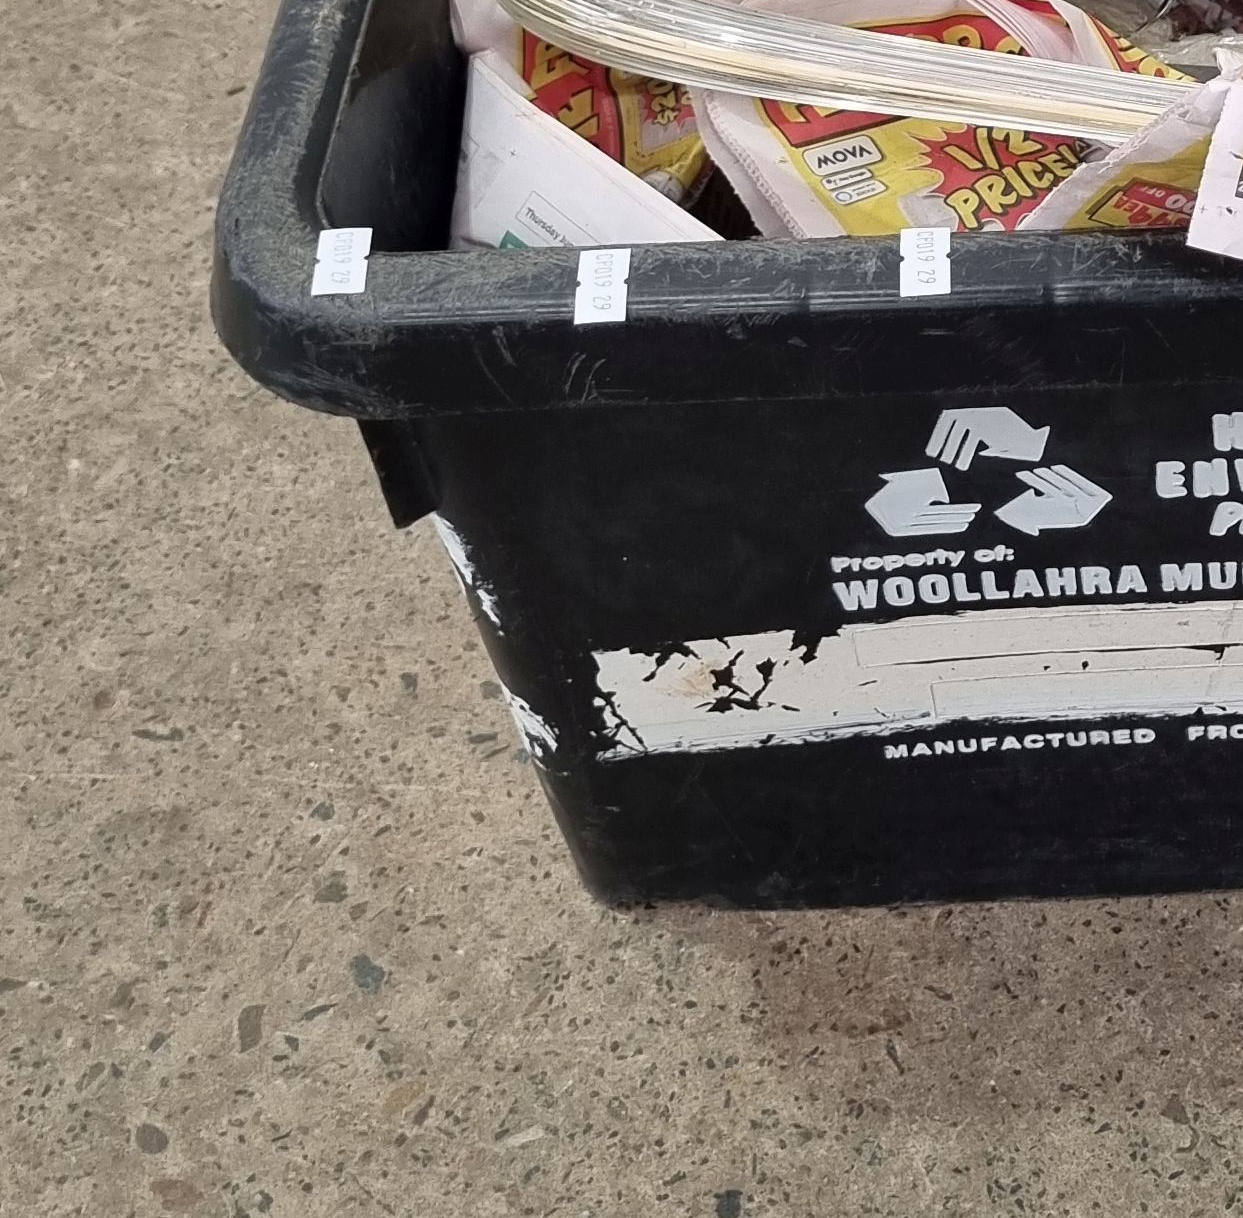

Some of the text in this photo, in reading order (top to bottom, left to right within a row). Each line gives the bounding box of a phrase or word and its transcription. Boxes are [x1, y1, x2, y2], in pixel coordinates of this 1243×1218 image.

[817, 144, 873, 169] MOVA
[944, 144, 1080, 229] PRICE!
[525, 205, 561, 241] Thursday
[915, 230, 937, 286] CP019 29
[332, 268, 352, 286] 29
[591, 252, 615, 312] CP019 29
[830, 544, 1015, 574] Property of:
[832, 563, 1148, 612] WOOLLAHRA
[883, 727, 1156, 760] MANUFACTURED
